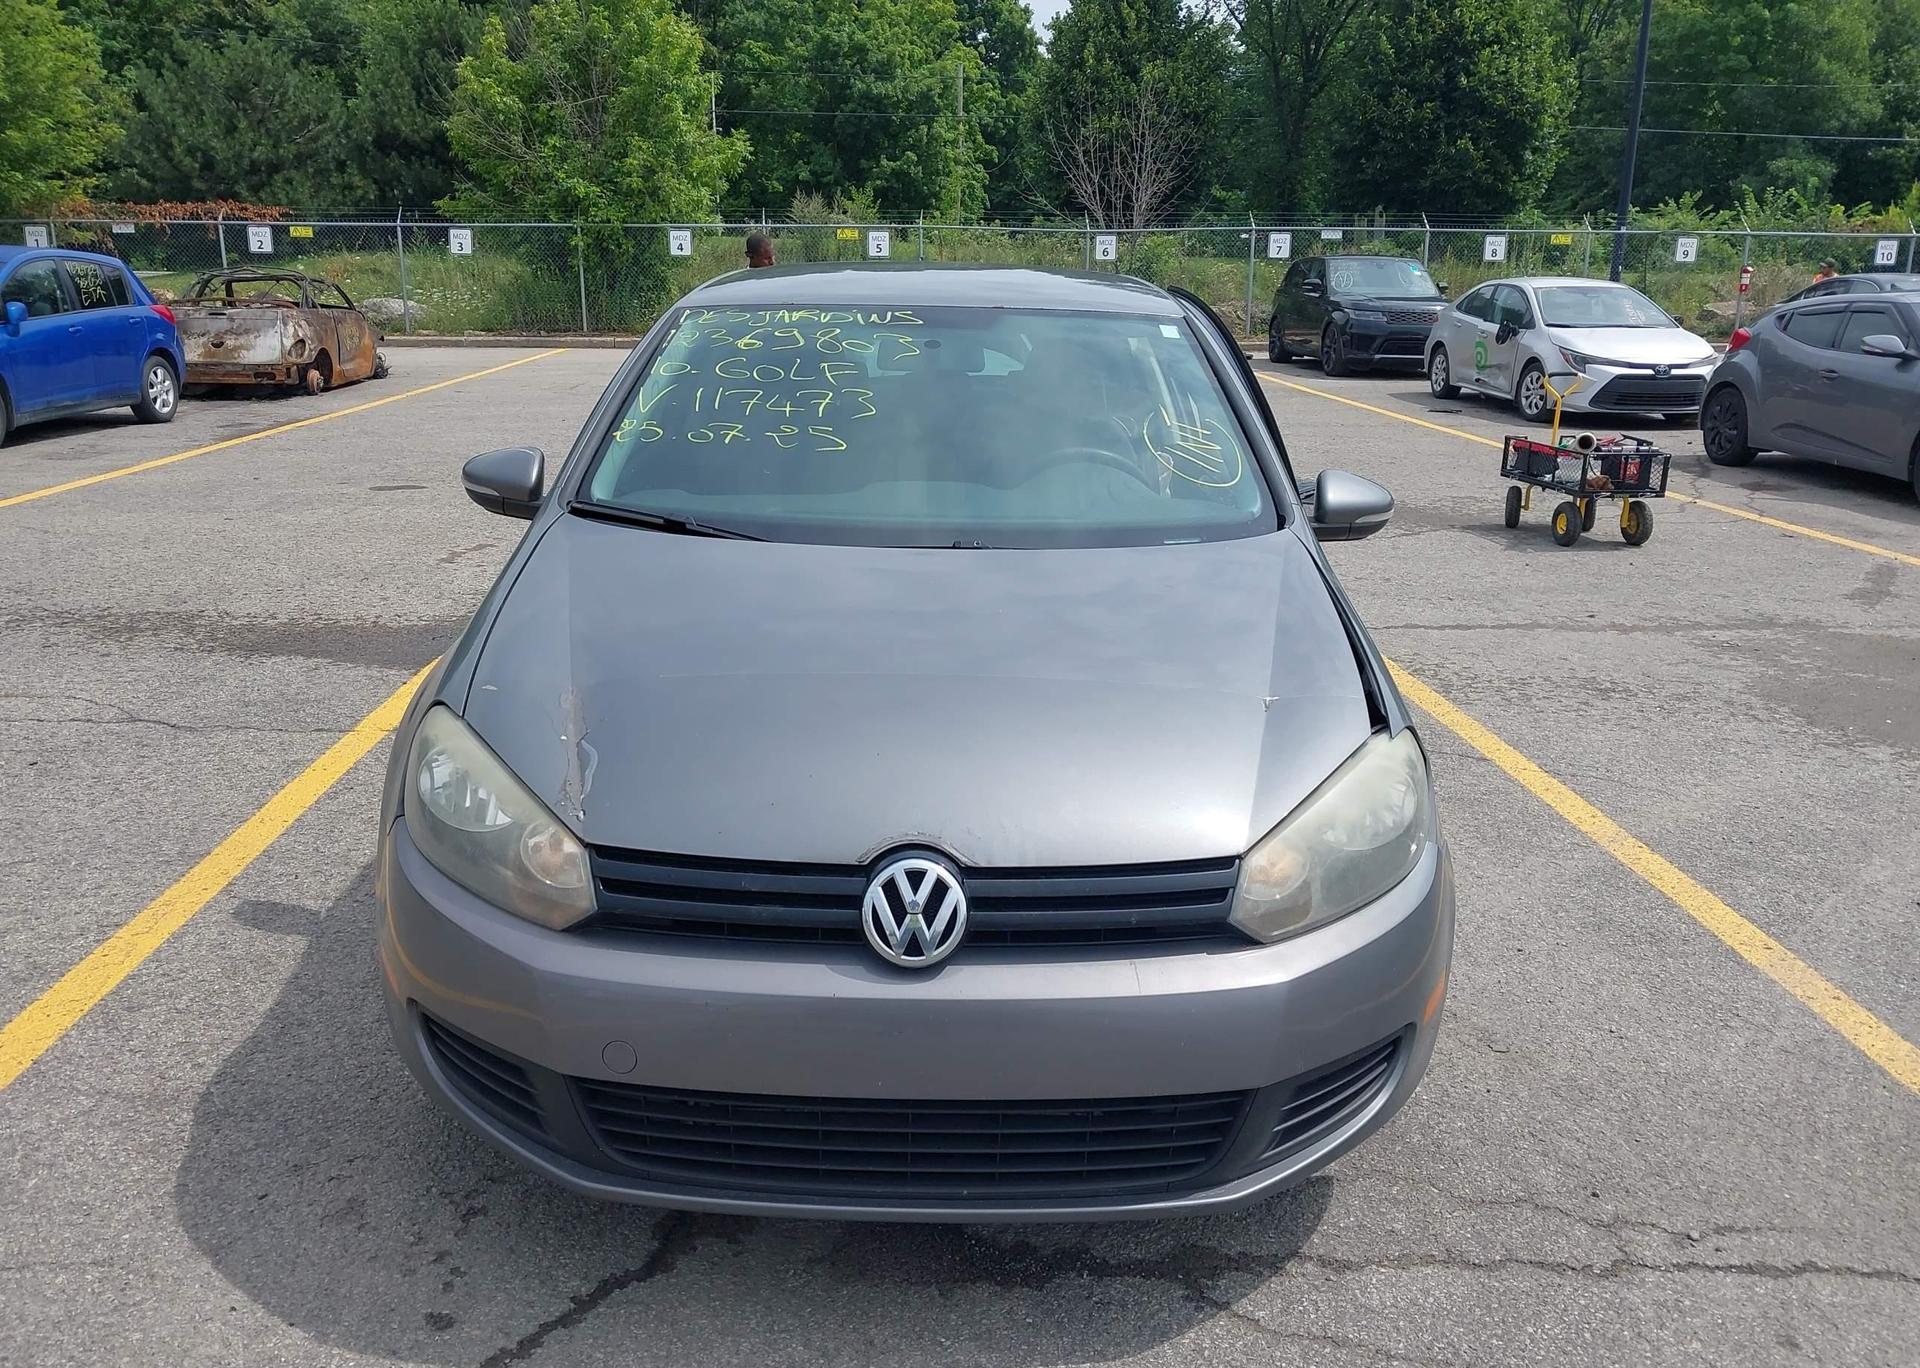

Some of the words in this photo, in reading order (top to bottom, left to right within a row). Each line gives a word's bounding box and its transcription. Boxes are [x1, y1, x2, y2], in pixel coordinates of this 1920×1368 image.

[34, 239, 40, 248] 1
[257, 240, 264, 250] 2
[457, 242, 464, 252] 3
[676, 243, 684, 252] 4
[875, 244, 882, 253] 5
[1102, 248, 1109, 257] 6
[1276, 246, 1283, 255] 7
[1490, 248, 1498, 257] 8
[1682, 249, 1689, 259] 9
[1880, 252, 1893, 261] 10
[716, 358, 859, 387] GOLF
[695, 386, 877, 419] 117473
